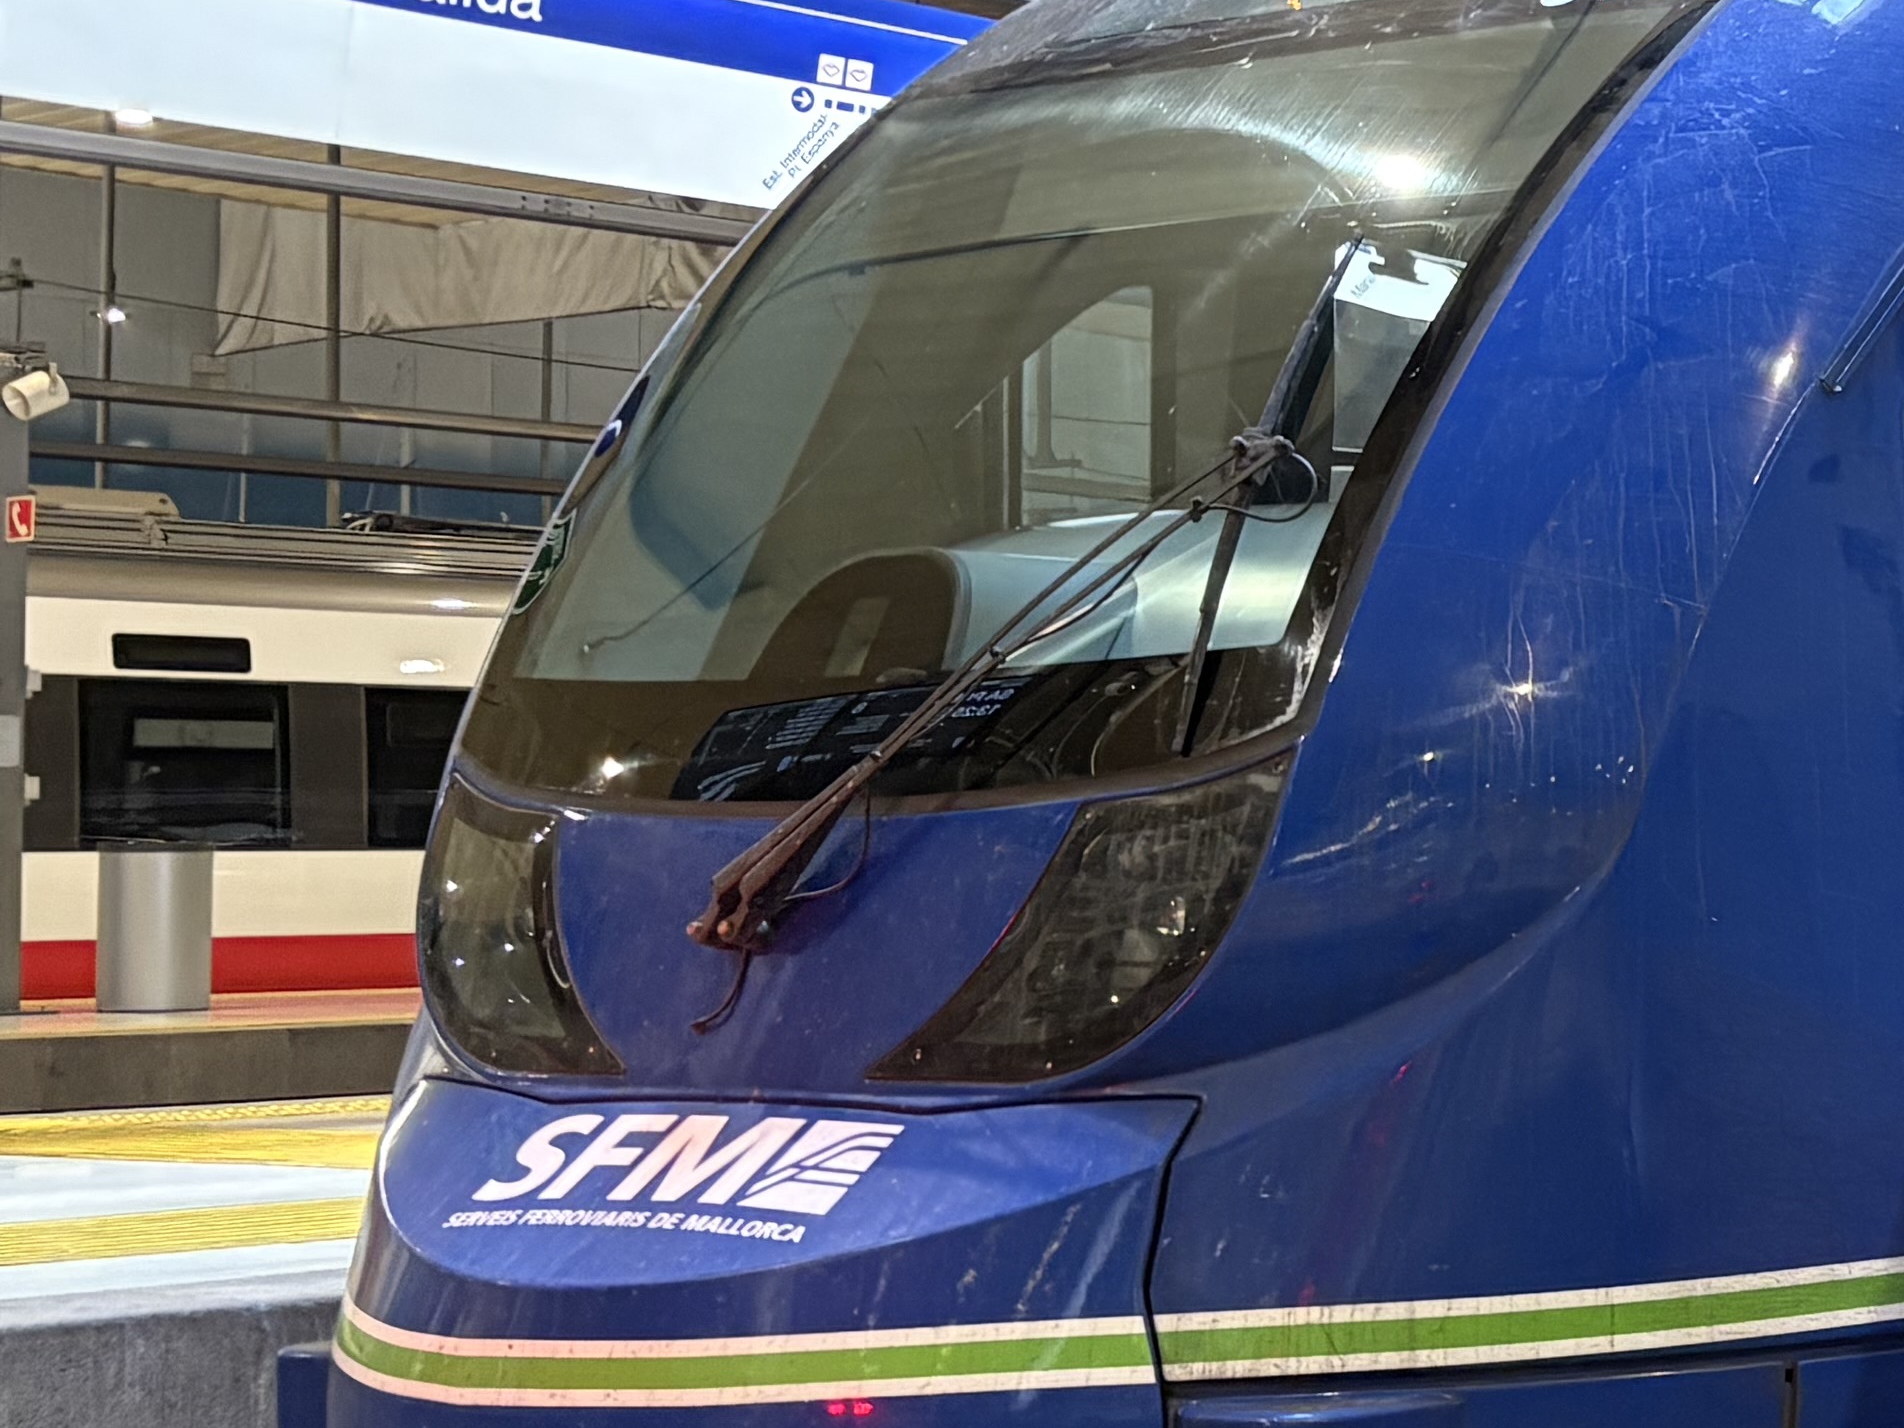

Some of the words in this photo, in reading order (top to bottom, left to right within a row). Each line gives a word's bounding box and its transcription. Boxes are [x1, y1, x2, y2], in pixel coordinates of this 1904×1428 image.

[471, 1113, 808, 1205] SFM
[442, 1209, 523, 1229] SERVEIS
[517, 1209, 649, 1229] FERROVIARIS
[647, 1211, 682, 1231] DE
[681, 1213, 807, 1243] MALLORCA
